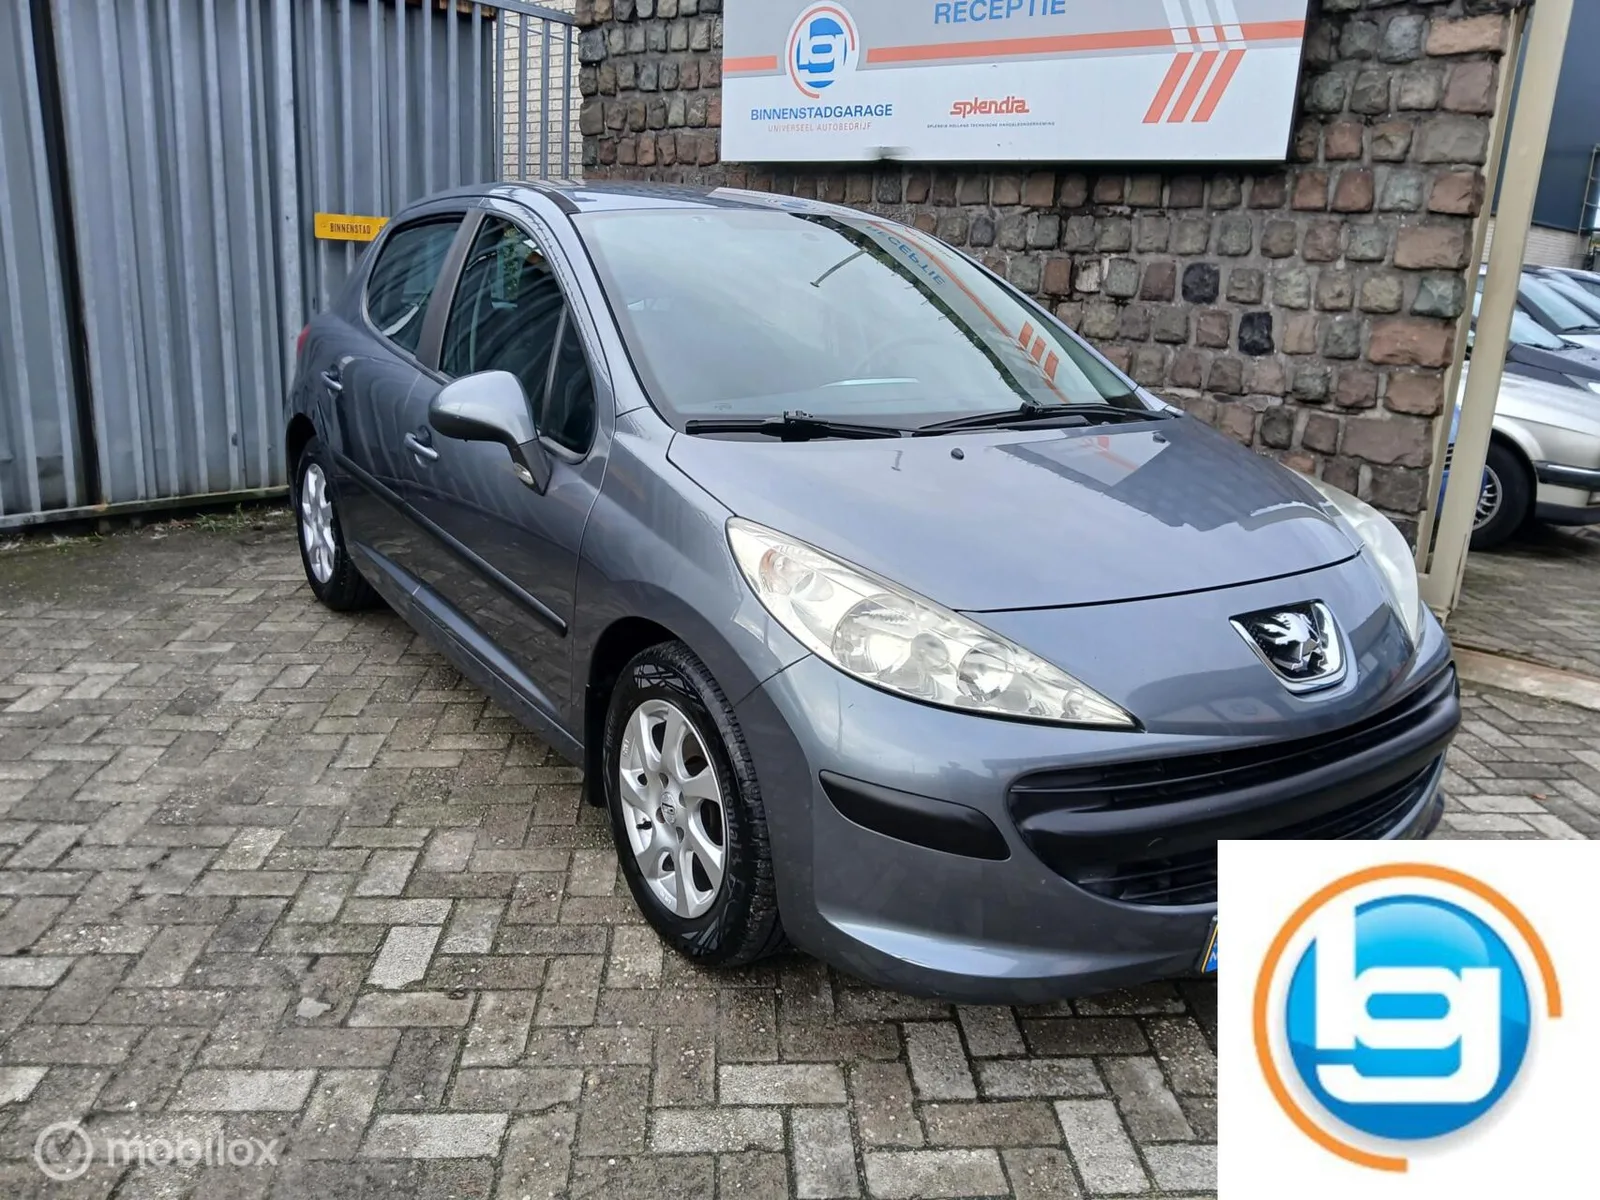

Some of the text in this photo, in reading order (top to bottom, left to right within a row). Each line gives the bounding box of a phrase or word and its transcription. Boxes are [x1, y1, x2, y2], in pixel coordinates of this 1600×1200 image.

[934, 0, 1066, 24] RECEPTIE
[751, 104, 893, 120] BINNENSTADGARAGE
[950, 96, 1030, 118] splendia
[768, 122, 872, 132] UNIVERSEEL AUTOBEDRIJF
[330, 222, 371, 234] BINNENSTAD
